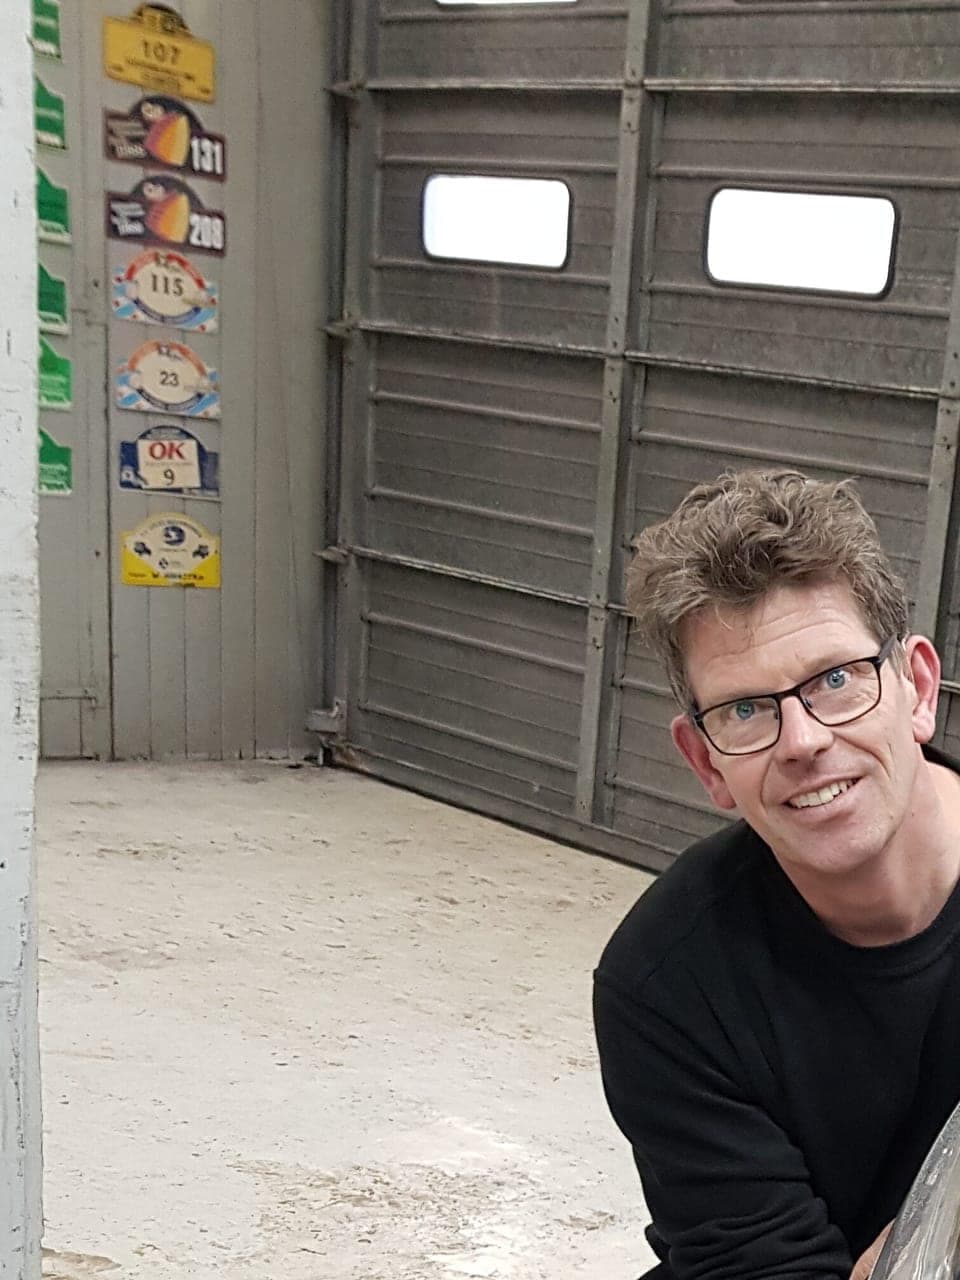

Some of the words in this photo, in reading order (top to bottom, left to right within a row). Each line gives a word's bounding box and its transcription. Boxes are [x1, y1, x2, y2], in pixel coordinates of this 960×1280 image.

[151, 274, 184, 296] 115
[159, 371, 180, 387] 23
[148, 441, 187, 460] OK
[163, 468, 175, 486] 9
